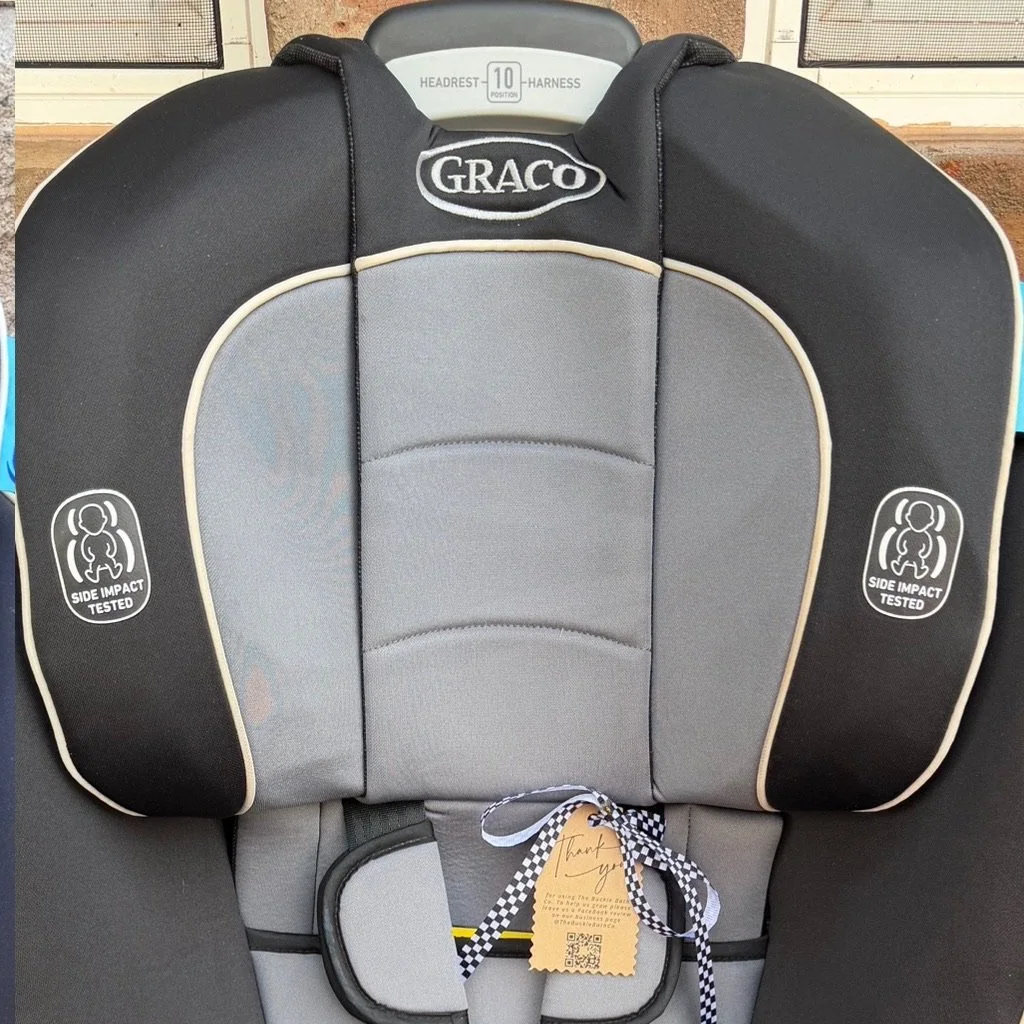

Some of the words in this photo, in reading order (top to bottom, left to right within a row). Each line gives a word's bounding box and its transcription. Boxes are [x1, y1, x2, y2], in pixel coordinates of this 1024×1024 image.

[420, 76, 480, 89] HEADREST
[493, 66, 513, 89] 10
[528, 77, 581, 89] HARNESS
[431, 155, 587, 195] GRACO
[71, 588, 99, 605] SIDE
[100, 579, 144, 599] IMPACT
[868, 576, 896, 592] SIDE
[897, 581, 943, 599] IMPACT
[88, 597, 134, 615] TESTED
[880, 592, 925, 611] TESTED
[555, 833, 621, 878] Thank
